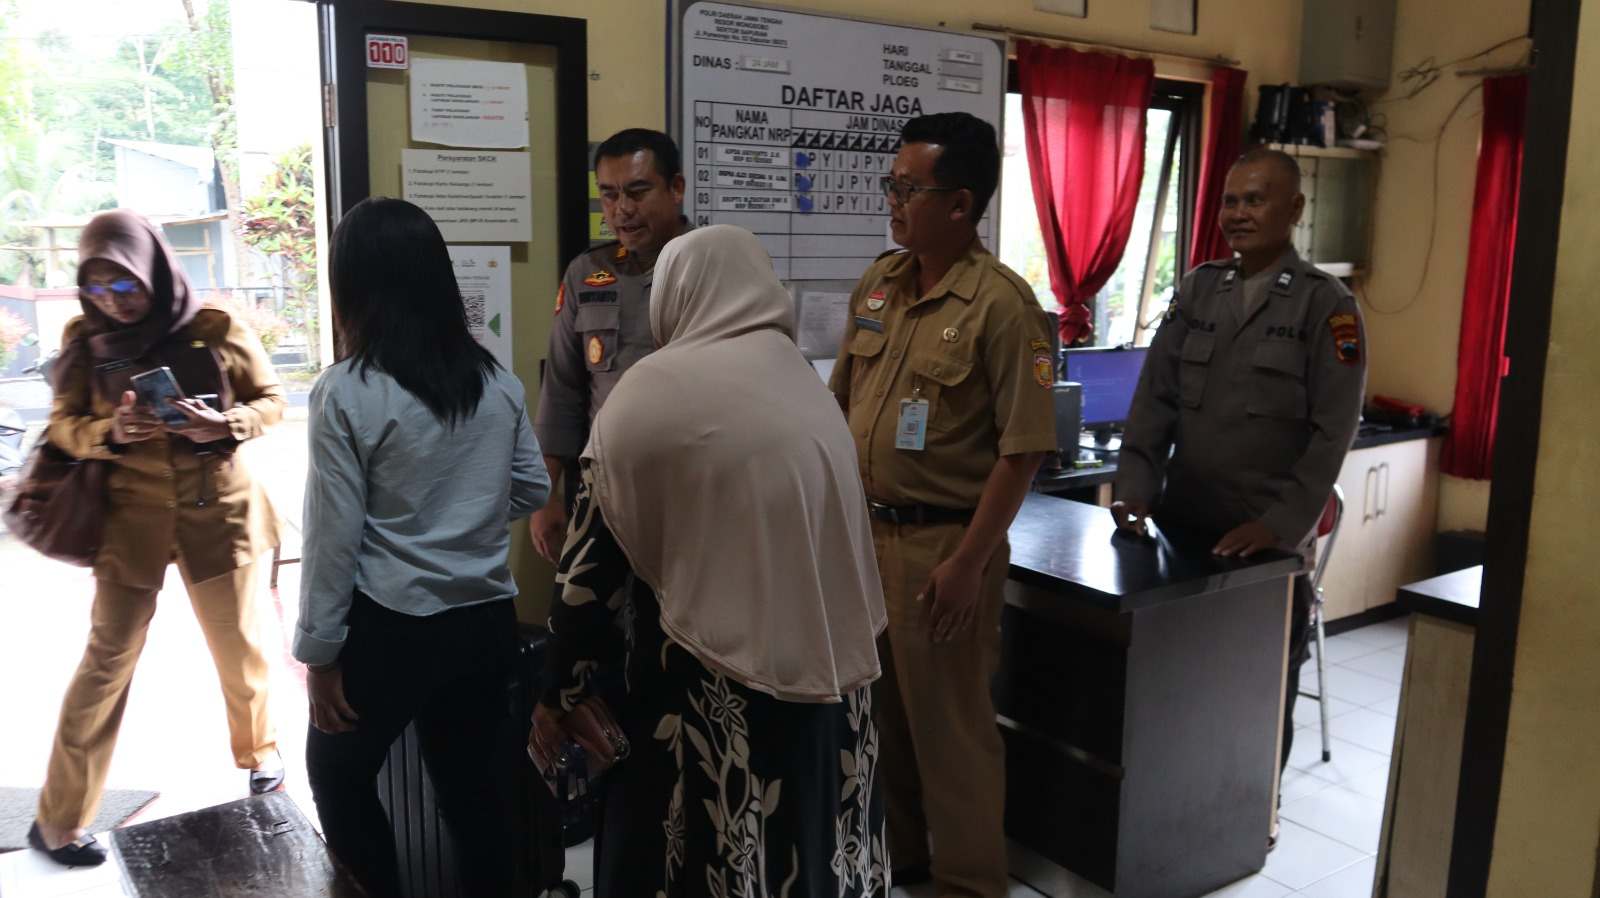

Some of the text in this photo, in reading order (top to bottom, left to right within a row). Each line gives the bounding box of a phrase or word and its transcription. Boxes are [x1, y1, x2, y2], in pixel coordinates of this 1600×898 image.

[369, 41, 405, 64] 110
[882, 43, 909, 56] HARI
[692, 54, 732, 70] DINAS
[882, 59, 933, 75] TANGGAL
[882, 74, 919, 88] PLOEG
[782, 85, 923, 116] DAFTAR JAGA
[695, 116, 712, 128] NO
[736, 109, 769, 124] NAMA
[846, 116, 904, 132] JAM DINAS
[711, 124, 766, 140] PANGKAT
[768, 128, 792, 142] NRP
[697, 147, 708, 159] 01
[823, 153, 831, 168] Y
[851, 154, 858, 169] J
[864, 155, 872, 169] P
[878, 156, 885, 170] Y
[697, 170, 709, 182] 02
[838, 176, 844, 189] J
[851, 176, 858, 190] P
[864, 177, 872, 191] Y
[697, 192, 709, 204] 03
[823, 195, 830, 210] J
[836, 196, 844, 211] P
[850, 196, 858, 211] Y
[878, 197, 884, 211] J
[697, 215, 709, 227] 04
